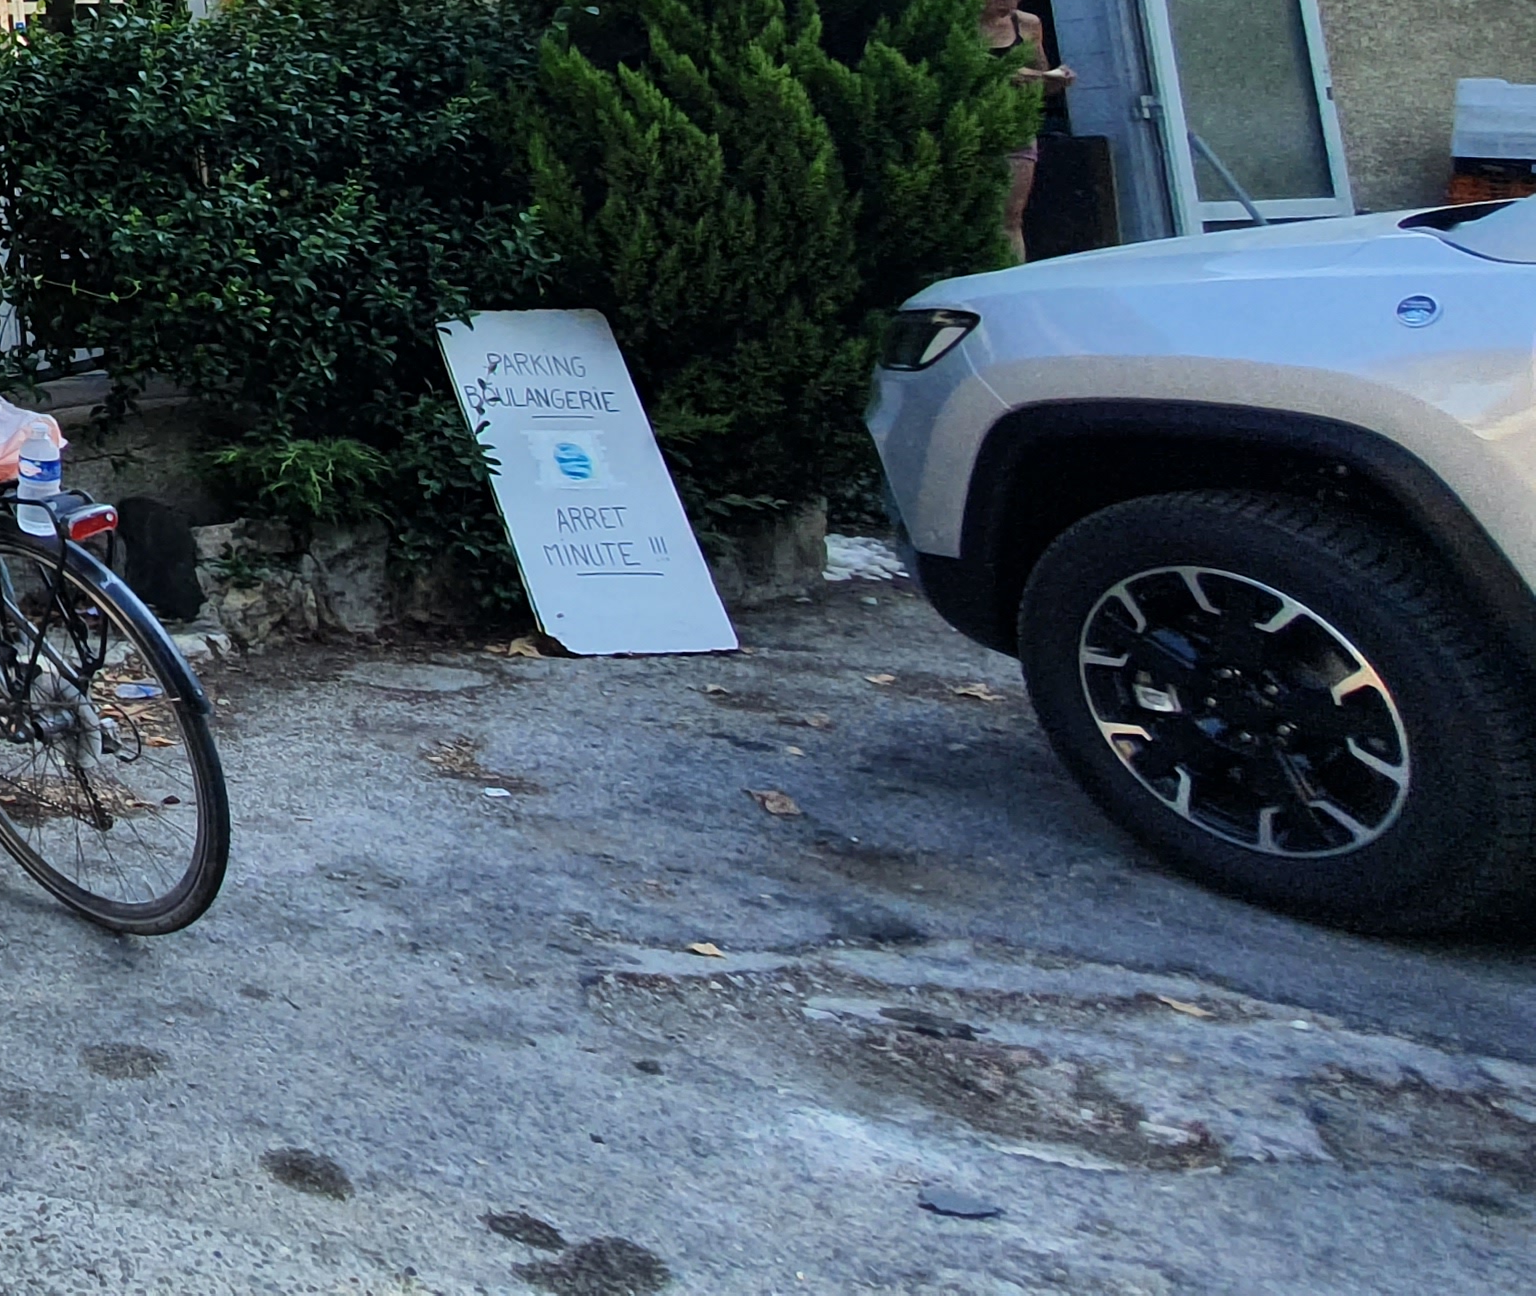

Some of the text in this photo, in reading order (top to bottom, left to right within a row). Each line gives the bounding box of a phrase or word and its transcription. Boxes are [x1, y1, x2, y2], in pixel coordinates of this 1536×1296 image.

[485, 352, 587, 378] PARKING
[463, 385, 621, 413] BOULANGERIE
[556, 506, 628, 534] ARRET
[542, 538, 642, 567] MINUTE
